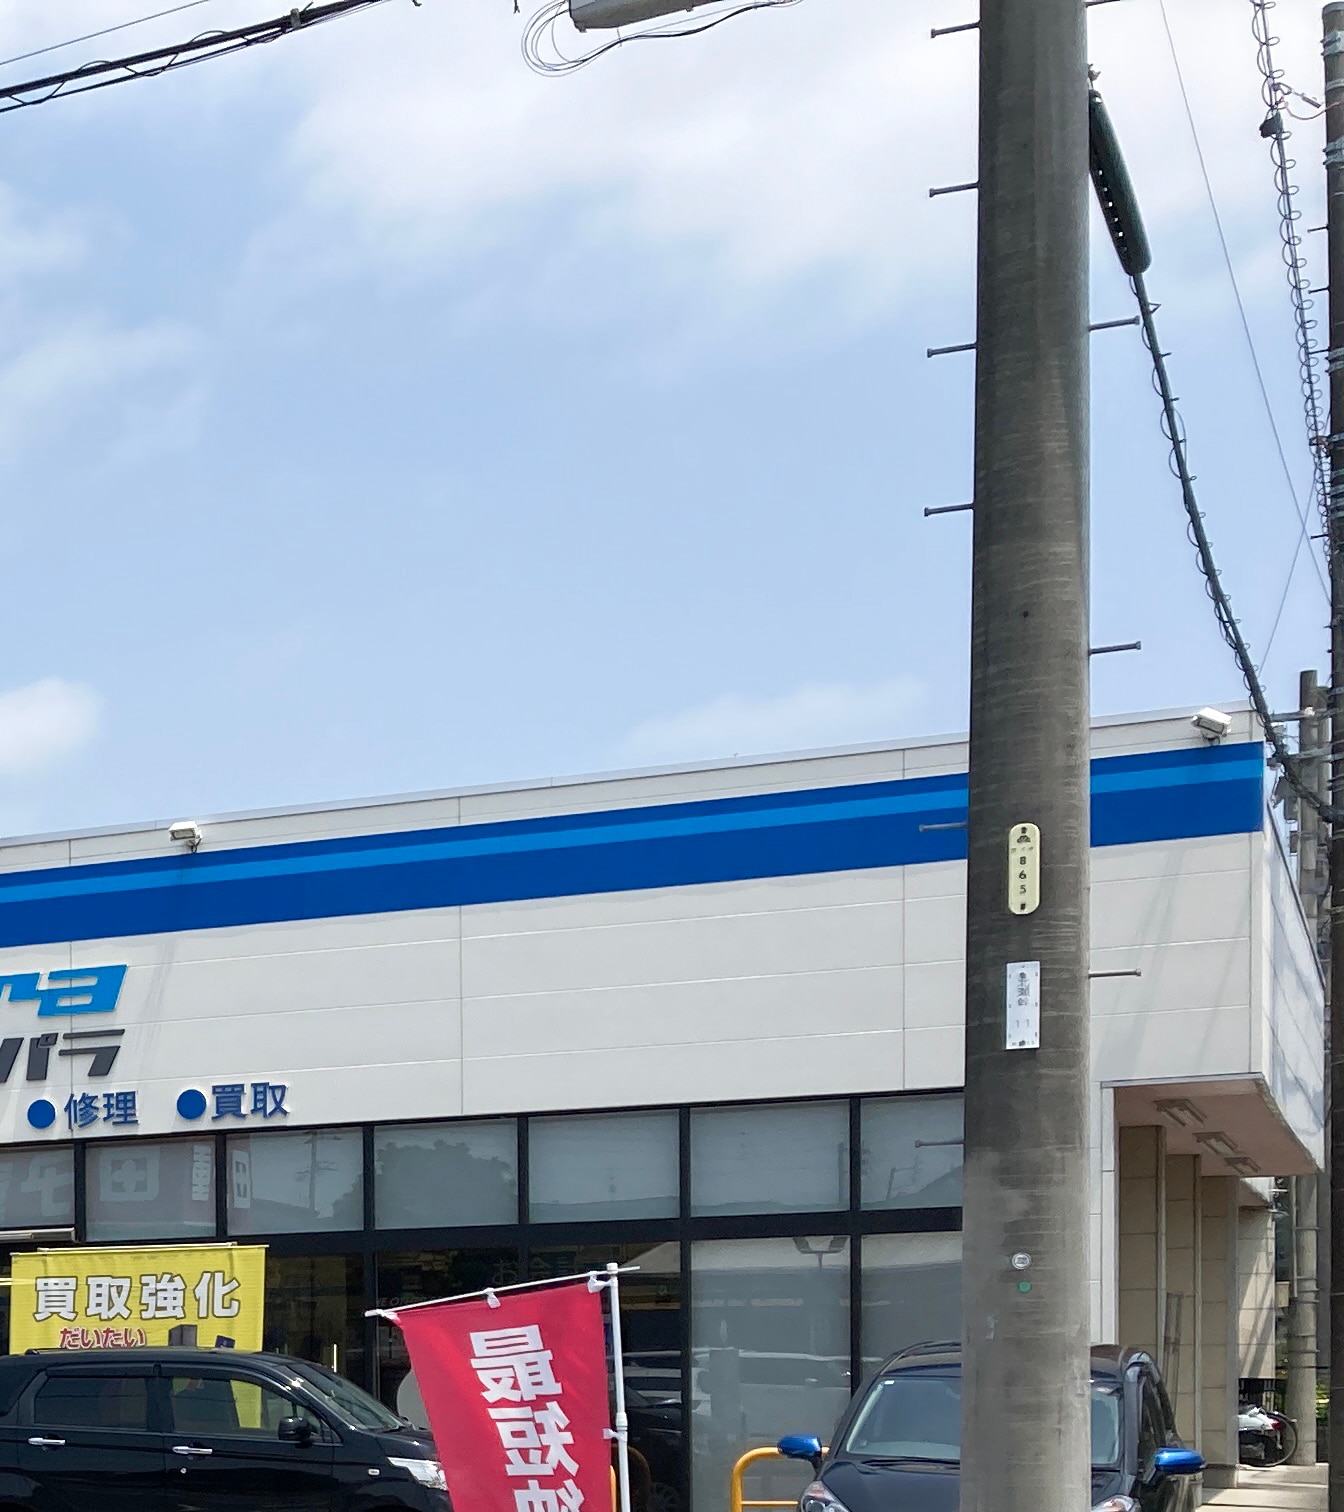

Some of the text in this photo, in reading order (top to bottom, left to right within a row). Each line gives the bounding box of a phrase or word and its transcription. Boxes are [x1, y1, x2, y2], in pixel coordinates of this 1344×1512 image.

[64, 1090, 140, 1129] 修理
[211, 1081, 289, 1120] 買取
[32, 1270, 240, 1322] 買取強化
[60, 1326, 146, 1349] だいたい
